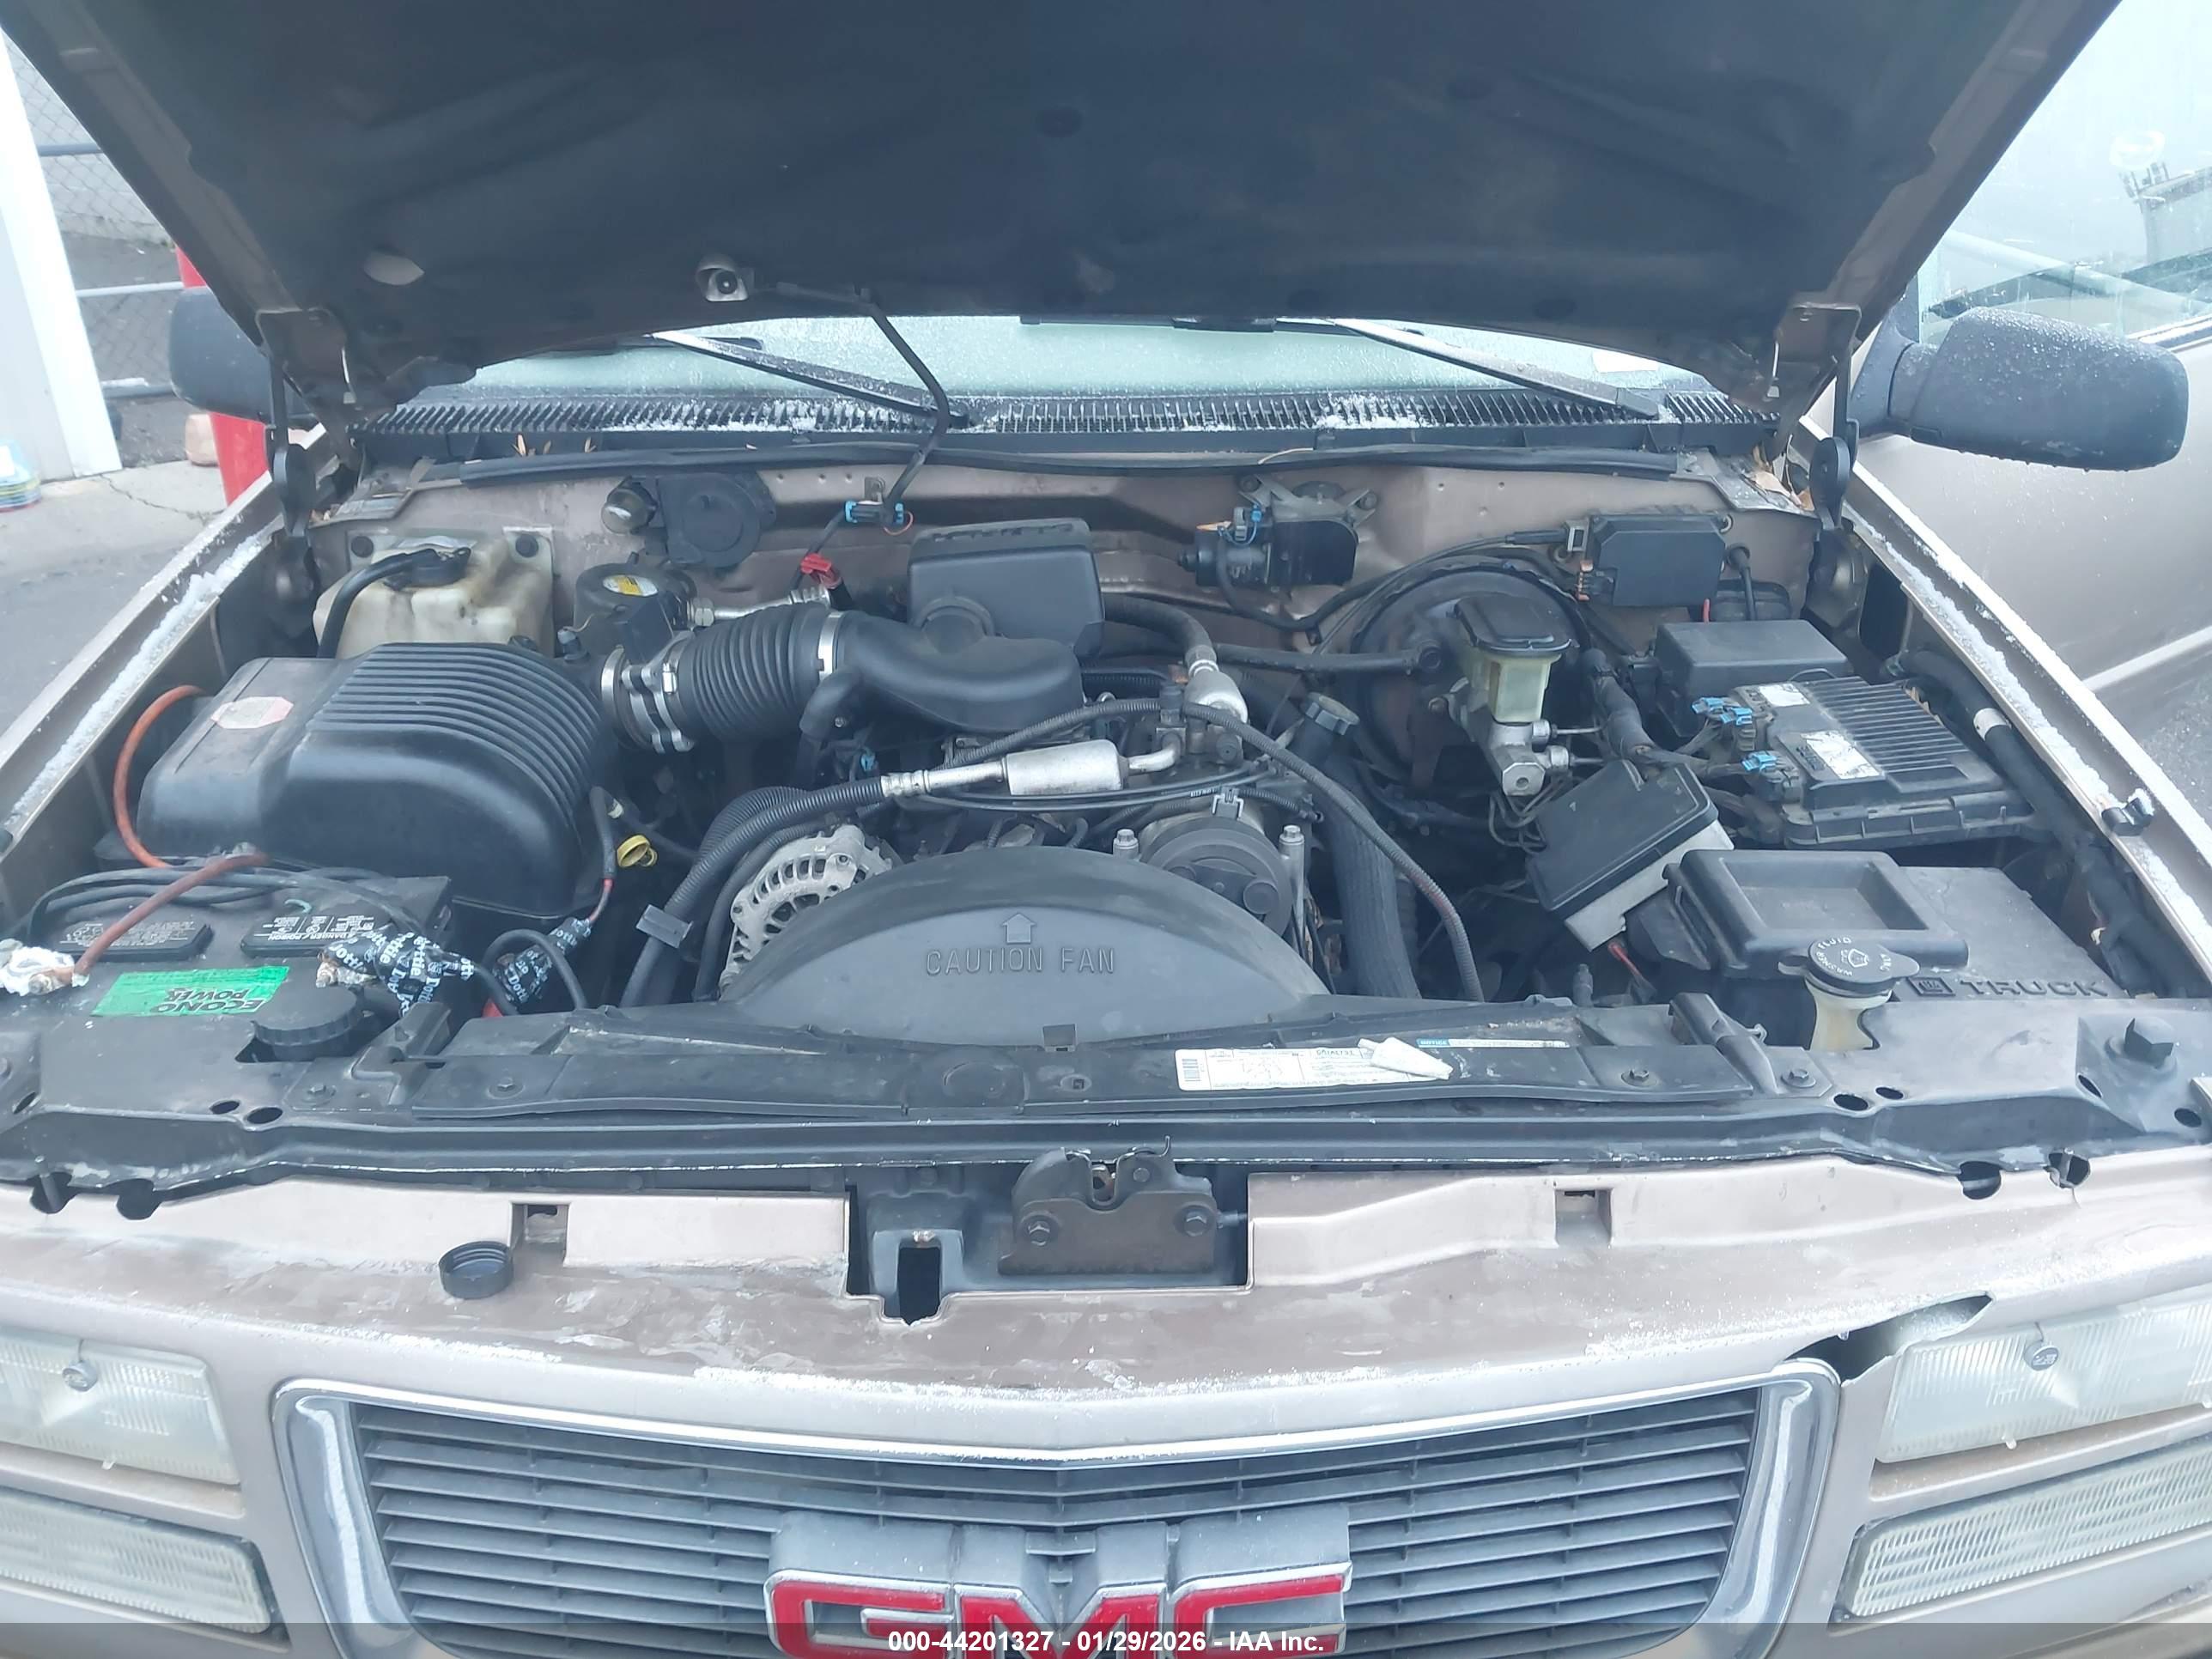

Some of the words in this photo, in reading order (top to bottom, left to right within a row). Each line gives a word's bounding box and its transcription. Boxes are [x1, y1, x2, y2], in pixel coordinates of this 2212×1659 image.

[1818, 937, 1852, 950] FLUID
[926, 947, 1043, 975] CAUTION
[1060, 947, 1115, 974] FAN
[163, 988, 250, 1002] POWER
[1960, 979, 2108, 997] TRUCK
[150, 999, 264, 1012] ECONO
[764, 1562, 1354, 1659] GMC
